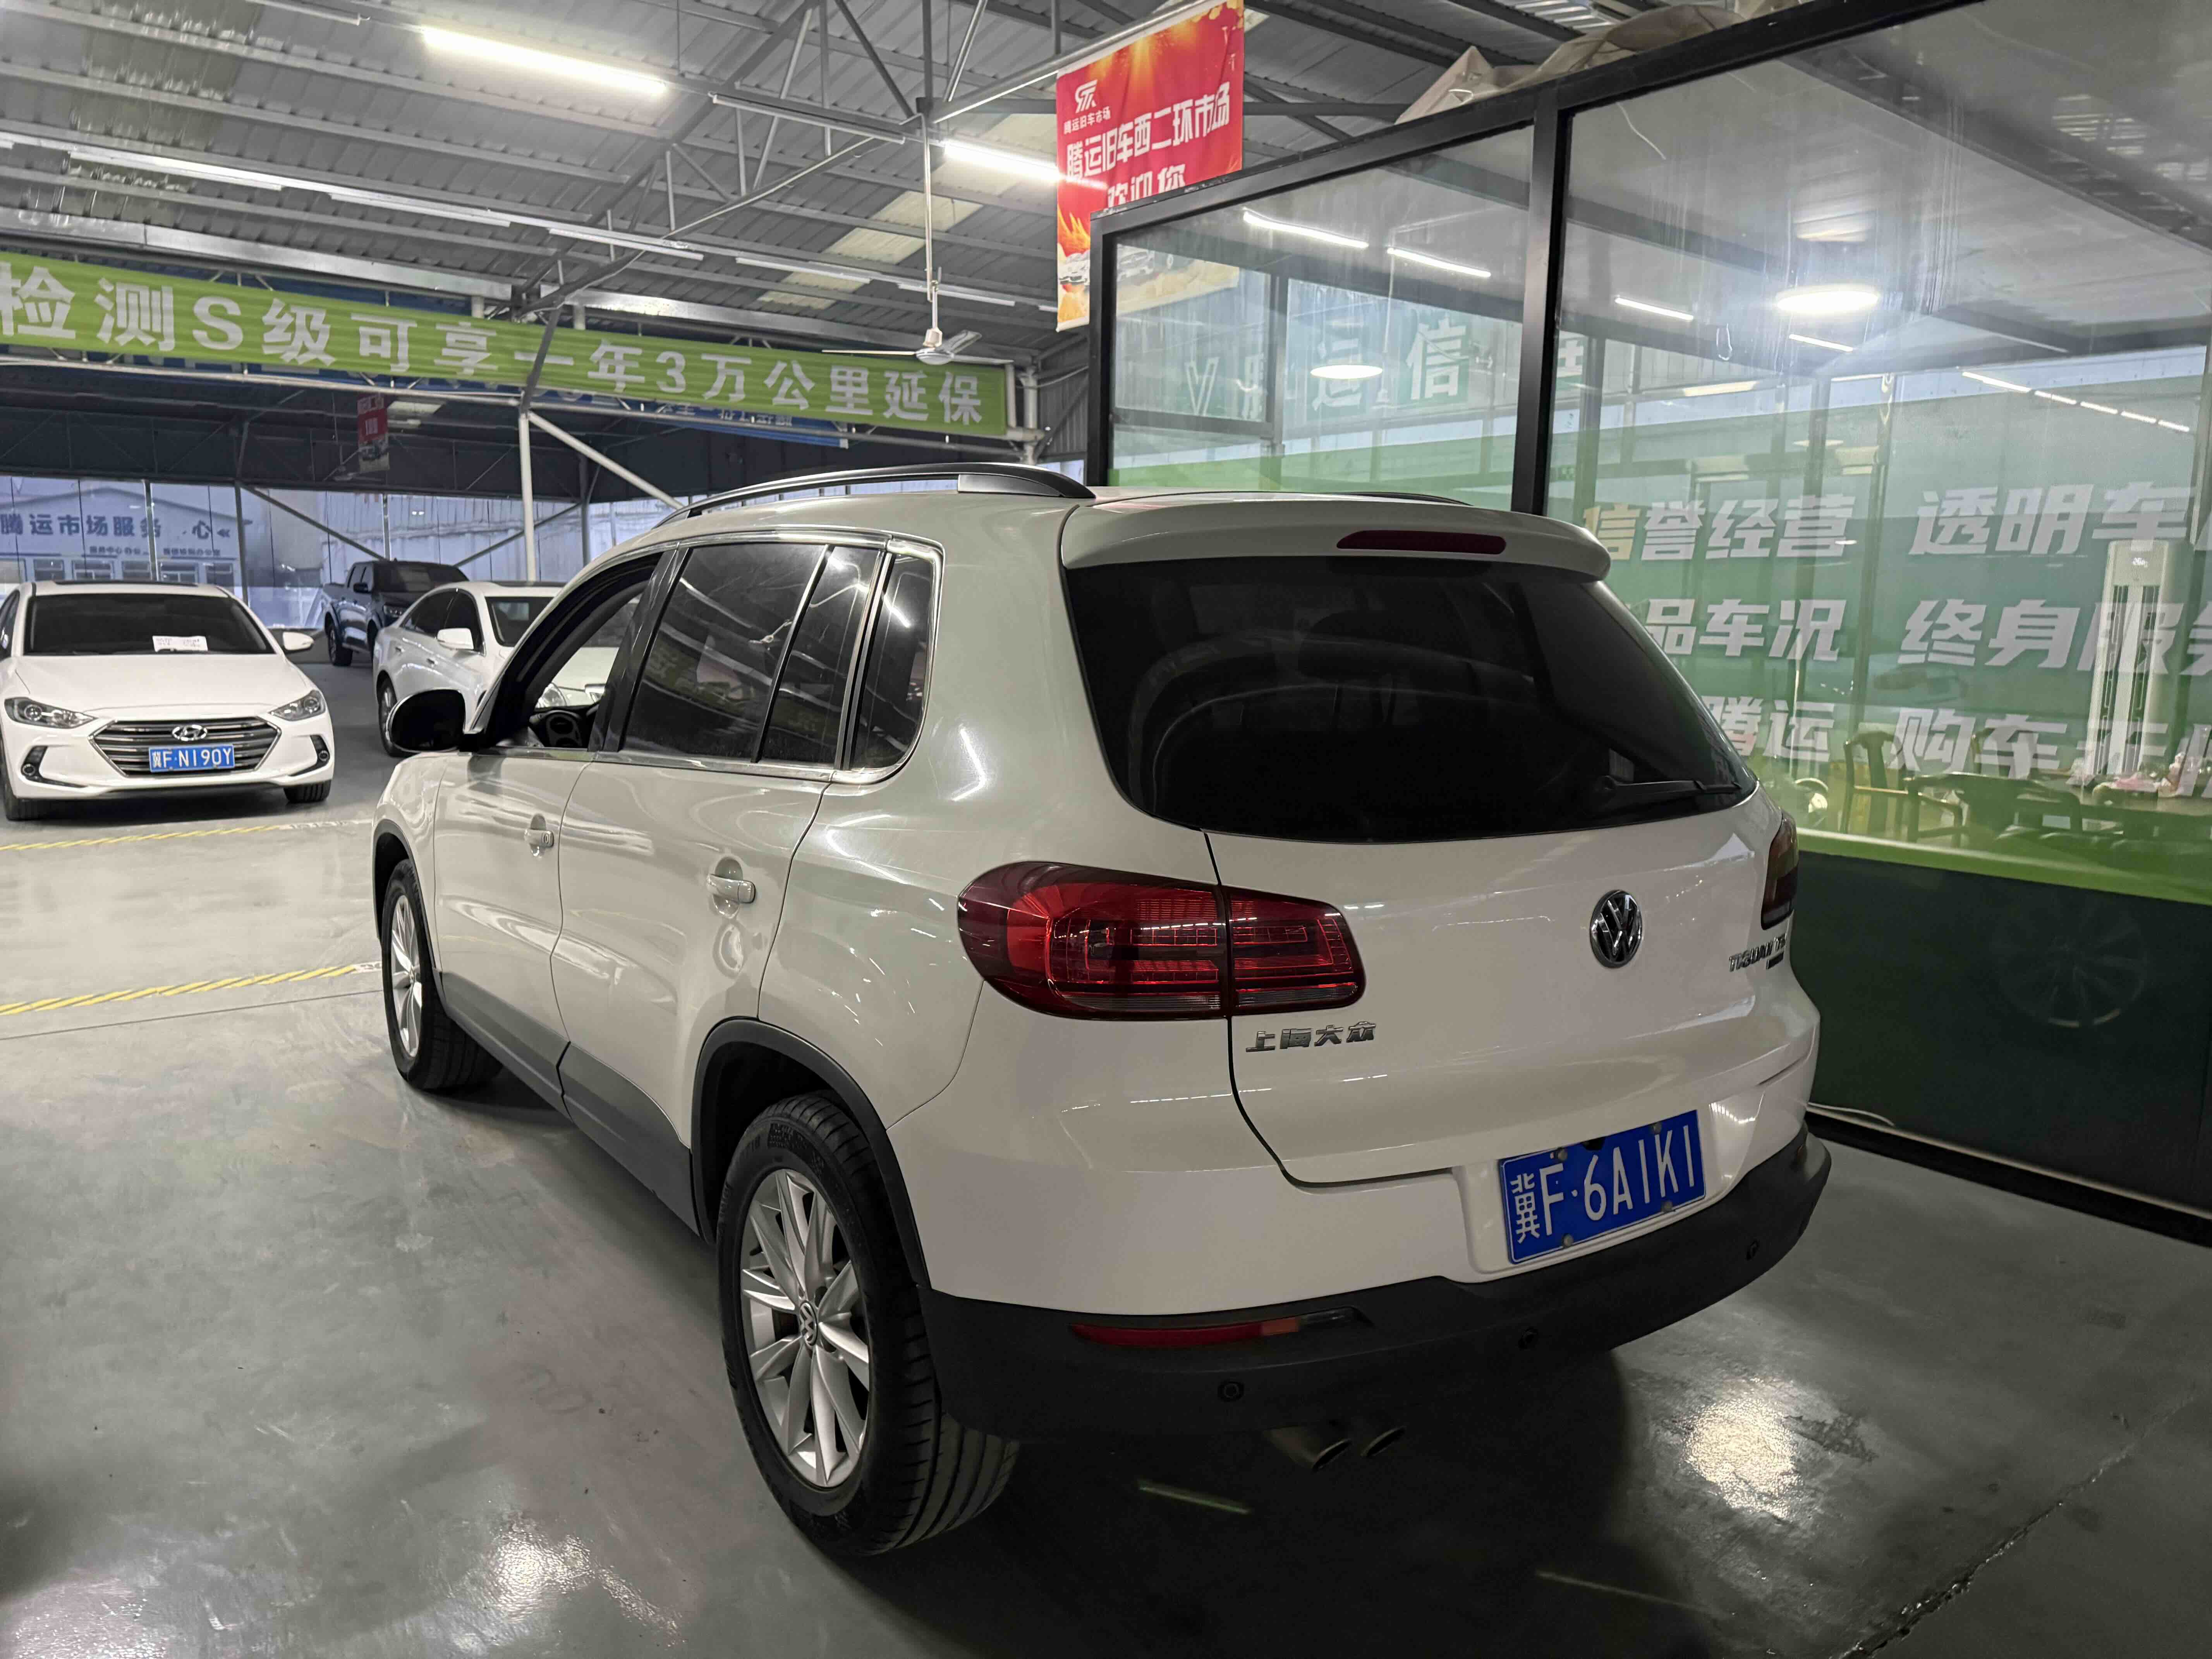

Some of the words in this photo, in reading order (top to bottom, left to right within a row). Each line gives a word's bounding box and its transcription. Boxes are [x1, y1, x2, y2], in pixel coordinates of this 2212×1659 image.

[1067, 81, 1230, 180] 腾运旧车西二环市场
[0, 262, 982, 426] 检测S级可享一年3万公里延保
[1, 513, 213, 539] 腾运市场服务心
[1583, 494, 1856, 560] 信誉经营
[1908, 481, 2212, 555] 透明车
[1626, 599, 1846, 661] 品车况
